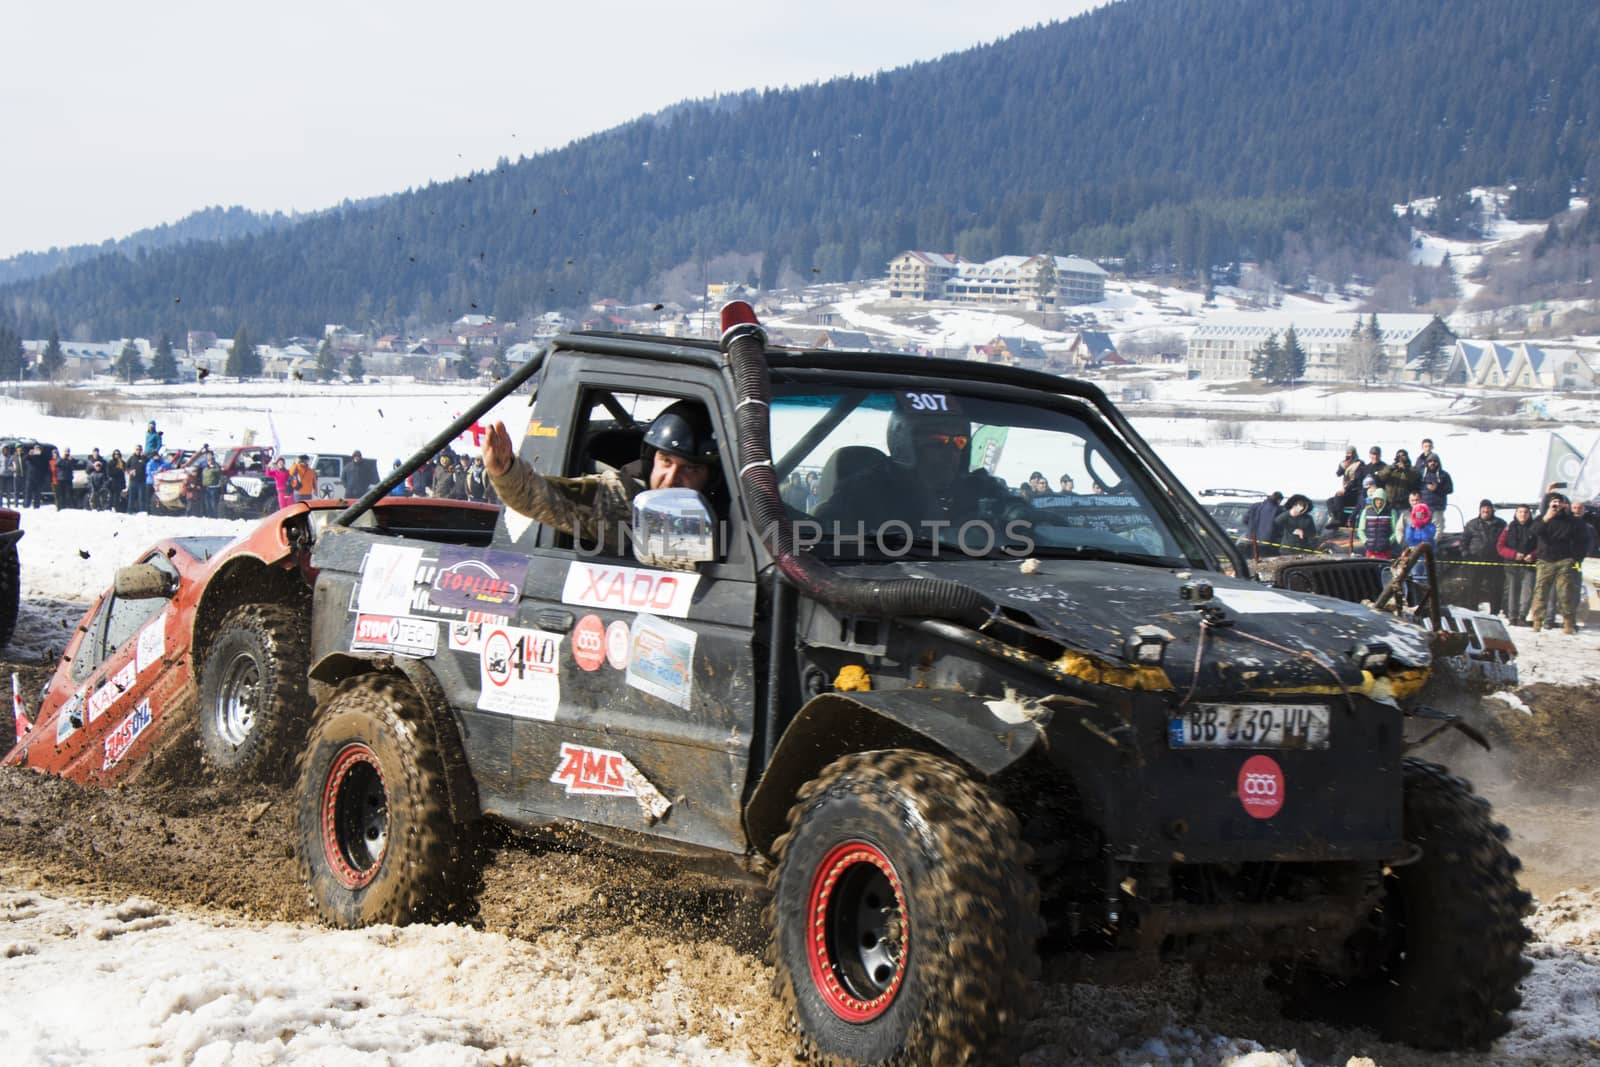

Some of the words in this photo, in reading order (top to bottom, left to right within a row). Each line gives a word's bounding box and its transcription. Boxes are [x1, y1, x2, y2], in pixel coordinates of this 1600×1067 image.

[906, 392, 949, 411] 307
[441, 573, 511, 597] TOPLINE
[579, 568, 679, 609] XADO
